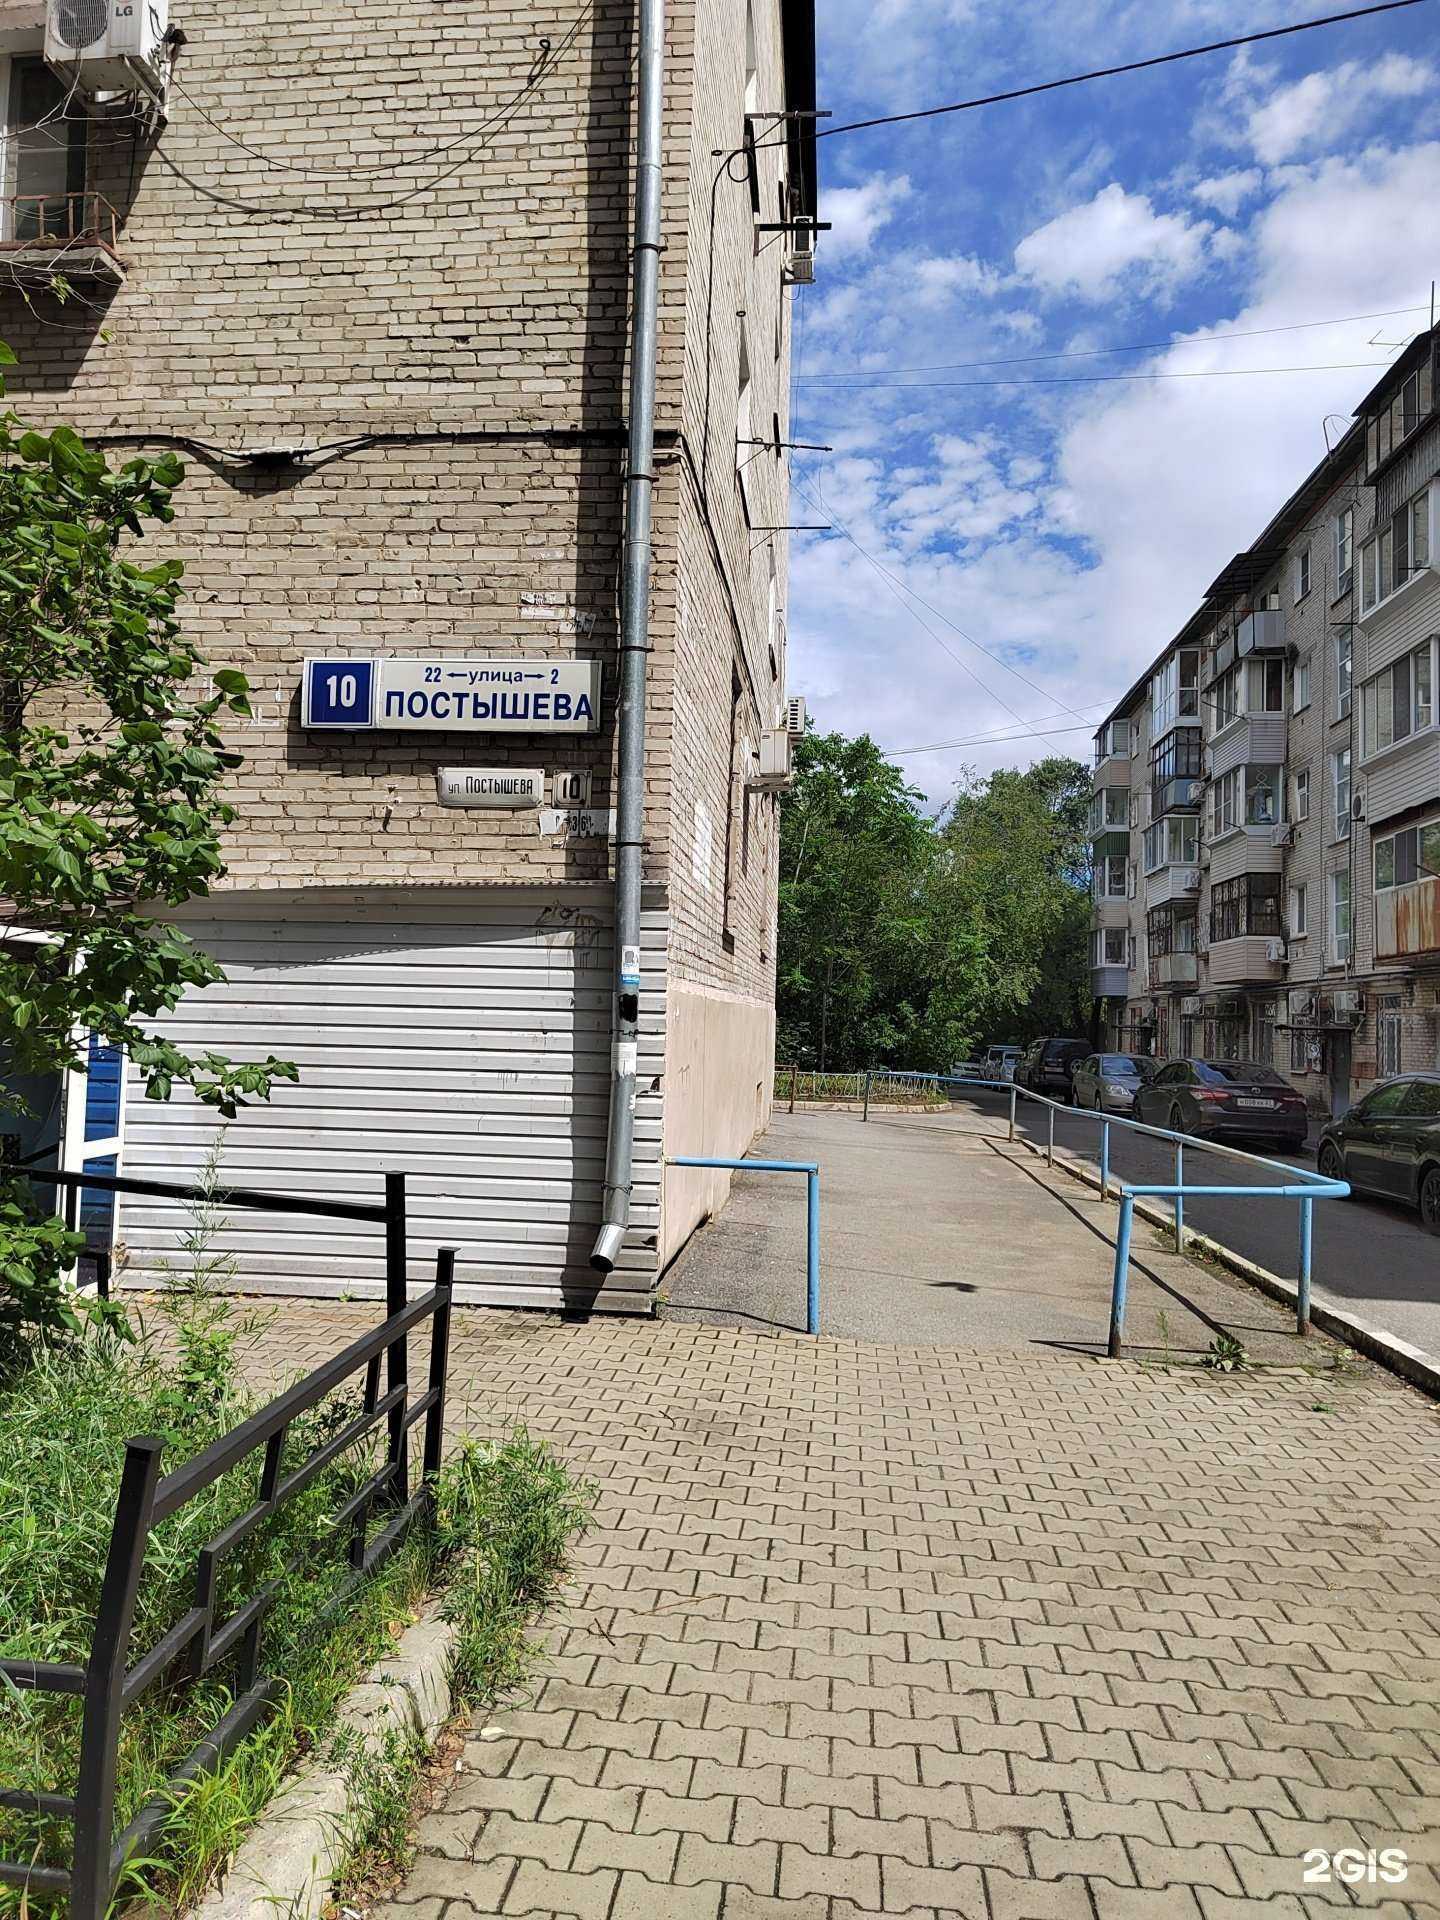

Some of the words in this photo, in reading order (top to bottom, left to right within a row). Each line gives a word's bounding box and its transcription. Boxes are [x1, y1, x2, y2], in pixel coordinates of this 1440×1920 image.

[115, 6, 133, 16] LG
[424, 667, 441, 682] 22
[468, 671, 523, 685] улица
[550, 668, 559, 684] 2
[326, 674, 357, 707] 10
[385, 691, 594, 720] ПОСТЫШЕВА
[562, 774, 582, 799] 10
